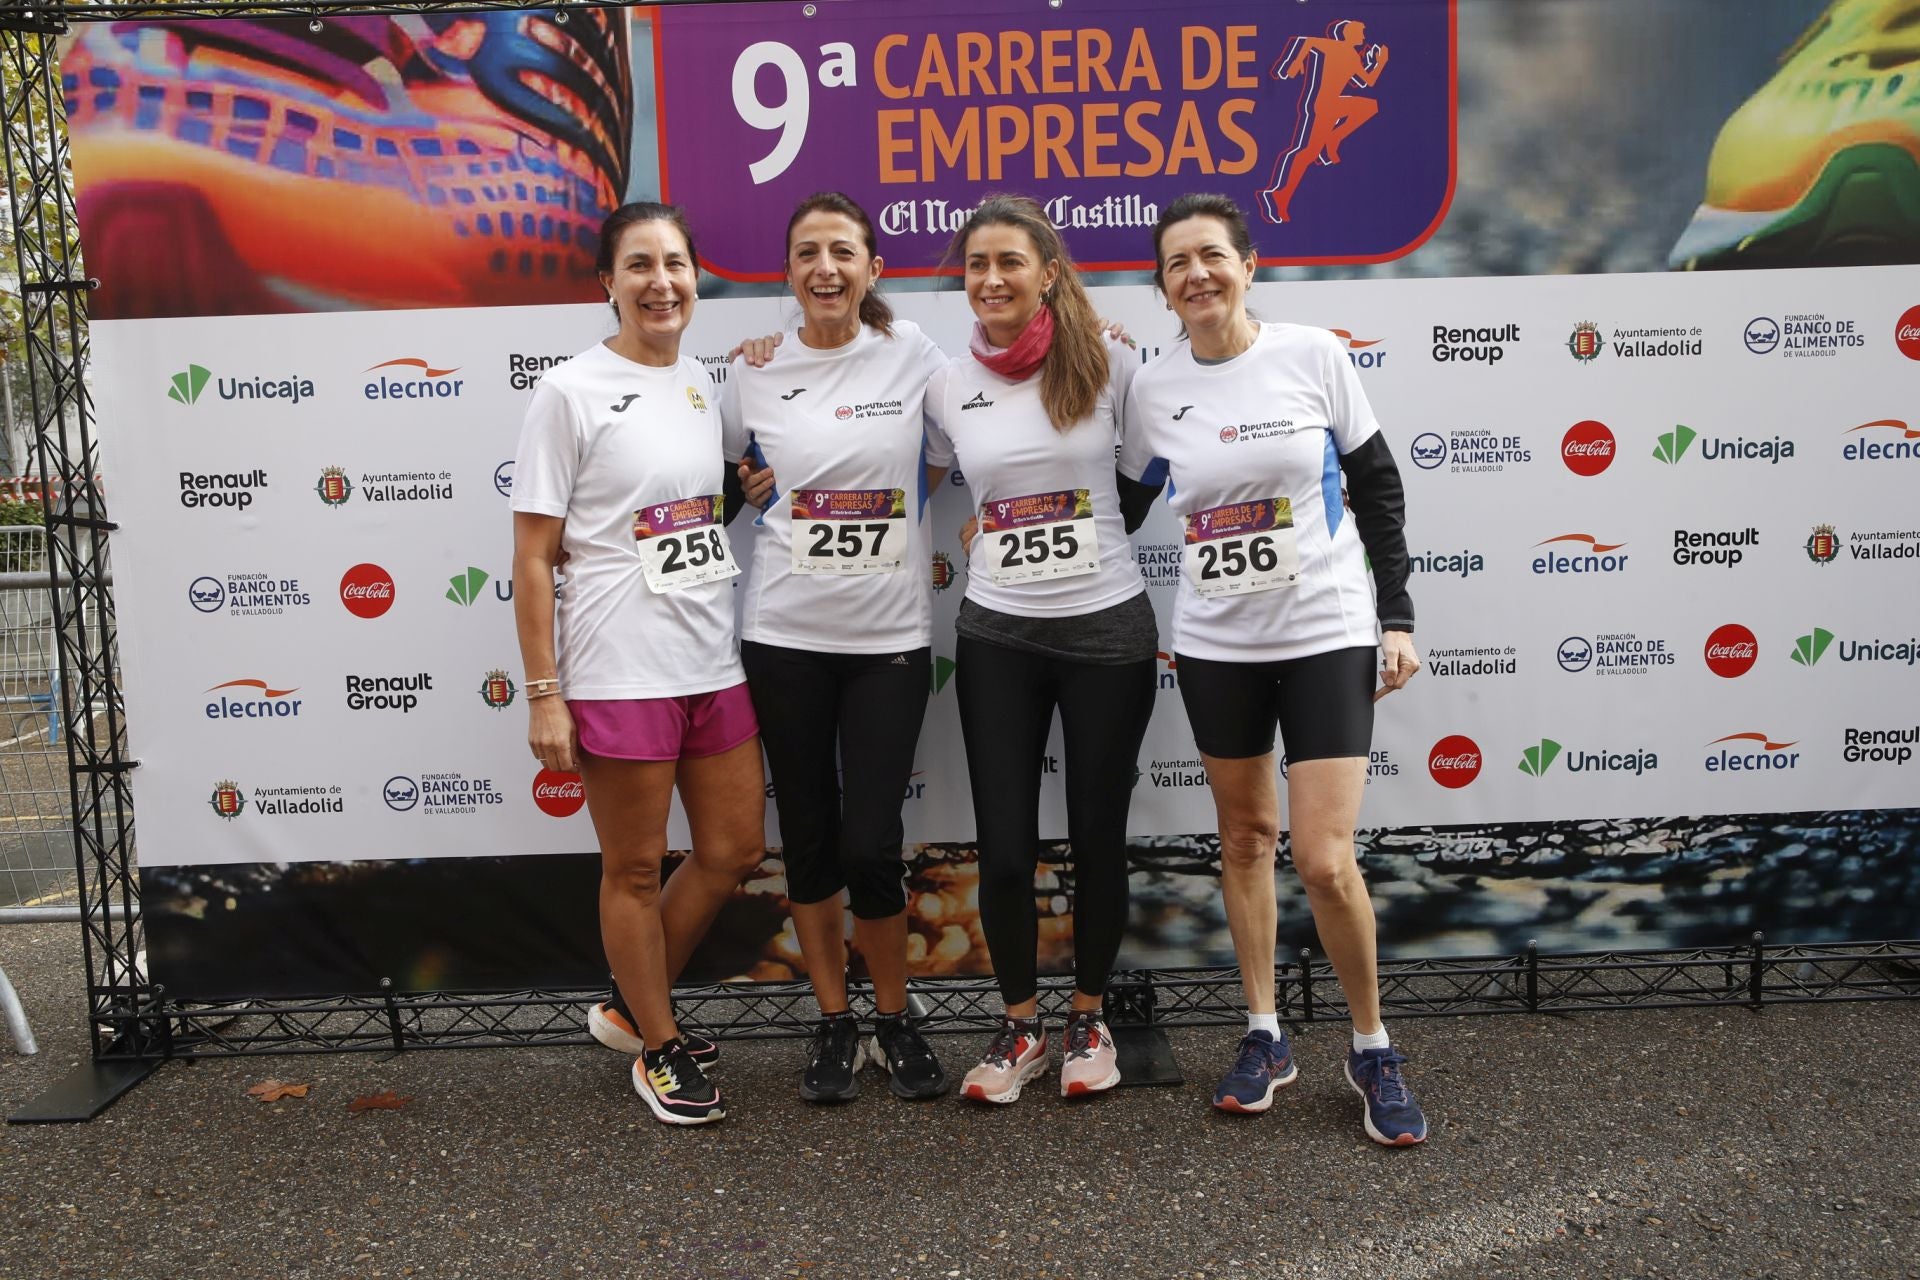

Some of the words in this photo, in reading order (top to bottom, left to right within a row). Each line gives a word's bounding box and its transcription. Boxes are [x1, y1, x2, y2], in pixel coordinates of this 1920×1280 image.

[873, 27, 1163, 99] CARRERA
[1181, 25, 1259, 91] DE
[731, 41, 857, 185] 9ª
[877, 98, 1259, 184] EMPRESAS
[879, 199, 919, 236] El
[921, 199, 986, 235] Nor
[1043, 193, 1160, 231] Castilla
[1784, 313, 1826, 322] FUNDACIÓN
[1432, 323, 1521, 344] Renault
[1613, 328, 1685, 342] Ayuntamiento
[1689, 326, 1703, 336] de
[1784, 322, 1828, 334] BANCO
[1835, 320, 1855, 333] DE
[1613, 339, 1702, 358] Valladolid
[1783, 334, 1865, 349] ALIMENTOS
[1432, 344, 1504, 366] Group
[1783, 350, 1796, 358] DE
[1797, 348, 1836, 358] VALLADOLID
[217, 375, 315, 404] Unicaja
[364, 377, 464, 400] elecnor
[961, 400, 995, 411] MERCURY
[1251, 428, 1295, 440] VALLADOLID
[1450, 429, 1492, 438] FUNDACIÓN
[1450, 437, 1495, 451] BANCO
[1502, 435, 1521, 449] DE
[1564, 437, 1613, 458] Coca-Cola
[1702, 435, 1795, 465] Unicaja
[1450, 449, 1532, 464] ALIMENTOS
[1450, 465, 1463, 473] DE
[1464, 464, 1504, 473] VALLADOLID
[179, 469, 268, 490] Renault
[361, 472, 434, 486] Ayuntamiento
[438, 470, 452, 480] de
[180, 489, 253, 511] Group
[361, 482, 453, 502] Valladolid
[830, 492, 862, 501] CARRERA
[863, 492, 873, 500] DE
[830, 500, 873, 510] EMPRESAS
[1010, 497, 1042, 509] CARRERA
[1043, 495, 1053, 504] DE
[1012, 503, 1055, 518] EMPRESAS
[671, 506, 706, 521] EMPRESS
[1211, 507, 1240, 519] CARRERA
[1241, 505, 1251, 514] DE
[1211, 513, 1252, 529] EMPRESAS
[808, 523, 889, 557] 257
[999, 524, 1078, 568] 255
[1674, 527, 1760, 548] Renault
[656, 528, 725, 574] 258
[1138, 544, 1179, 552] FUNDACIÓN
[1850, 542, 1920, 560] Valladol
[1198, 536, 1278, 580] 256
[1409, 549, 1484, 578] nicaja
[1531, 551, 1629, 575] elecnor
[1672, 547, 1743, 569] Group
[227, 573, 268, 581] FUNDACIÓN
[1140, 565, 1180, 578] ALIME
[228, 581, 275, 594] BANCO
[279, 579, 299, 592] DE
[343, 580, 391, 600] Coca-Cola
[229, 593, 311, 608] ALIMENTOS
[230, 609, 241, 617] DE
[242, 607, 284, 616] VALLADOLID
[1596, 633, 1636, 641] FUNDACIÓN
[1428, 647, 1501, 661] Ayuntamiento
[1503, 645, 1517, 656] de
[1596, 641, 1640, 654] BANCO
[1646, 639, 1665, 652] DE
[1706, 641, 1755, 660] Coca-Cola
[1428, 657, 1517, 677] Valladolid
[1596, 653, 1675, 667] ALIMENTOS
[1596, 668, 1607, 676] DE
[1608, 666, 1648, 675] VALLADOLID
[345, 672, 433, 693] Renault
[205, 697, 302, 719] elecnor
[346, 692, 418, 714] Group
[1844, 725, 1920, 745] Renaul
[1370, 751, 1389, 763] DE
[1432, 753, 1479, 772] Coca-Cola
[1567, 748, 1658, 777] Unicaja
[1704, 749, 1800, 772] elecnor
[1843, 745, 1912, 766] Group
[1150, 758, 1204, 771] Ayuntamie
[421, 772, 461, 781] FUNDACIÓN
[254, 785, 327, 801] Ayuntamiento
[329, 784, 342, 794] de
[422, 780, 467, 793] BANCO
[472, 778, 492, 792] DE
[535, 781, 583, 799] Coca-Cola
[255, 797, 344, 815] Valladolid
[423, 792, 504, 807] ALIMENTOS
[424, 807, 436, 815] DE
[437, 805, 476, 814] VALLADOLID
